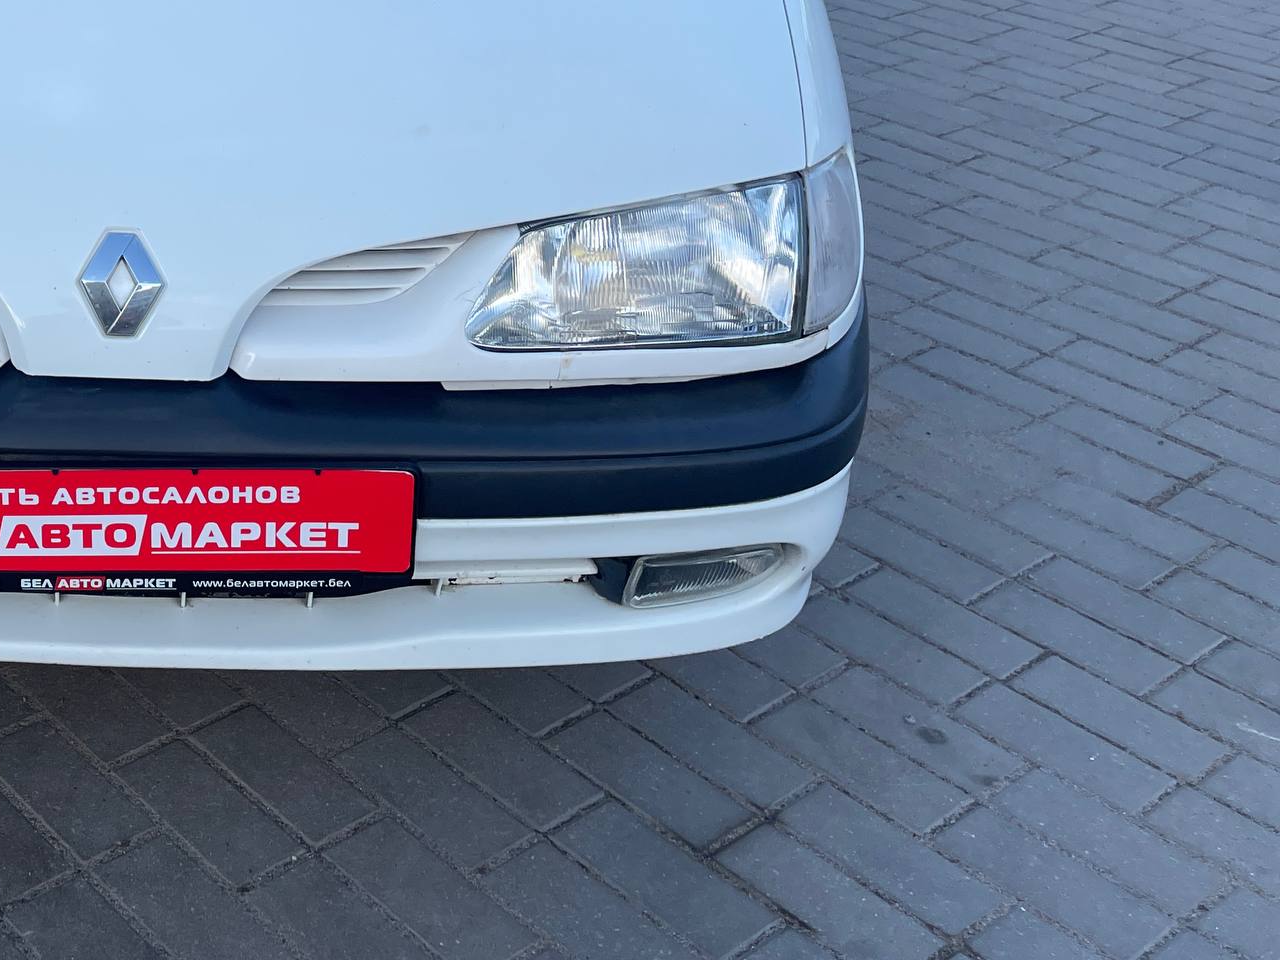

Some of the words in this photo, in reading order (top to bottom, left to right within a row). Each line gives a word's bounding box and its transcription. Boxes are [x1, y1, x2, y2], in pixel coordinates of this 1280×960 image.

[51, 486, 301, 505] АВТОСАЛОНОВ
[5, 523, 138, 549] АВТО
[150, 522, 360, 549] МАРКЕТ
[192, 578, 352, 589] www.белавтомаркет.бел
